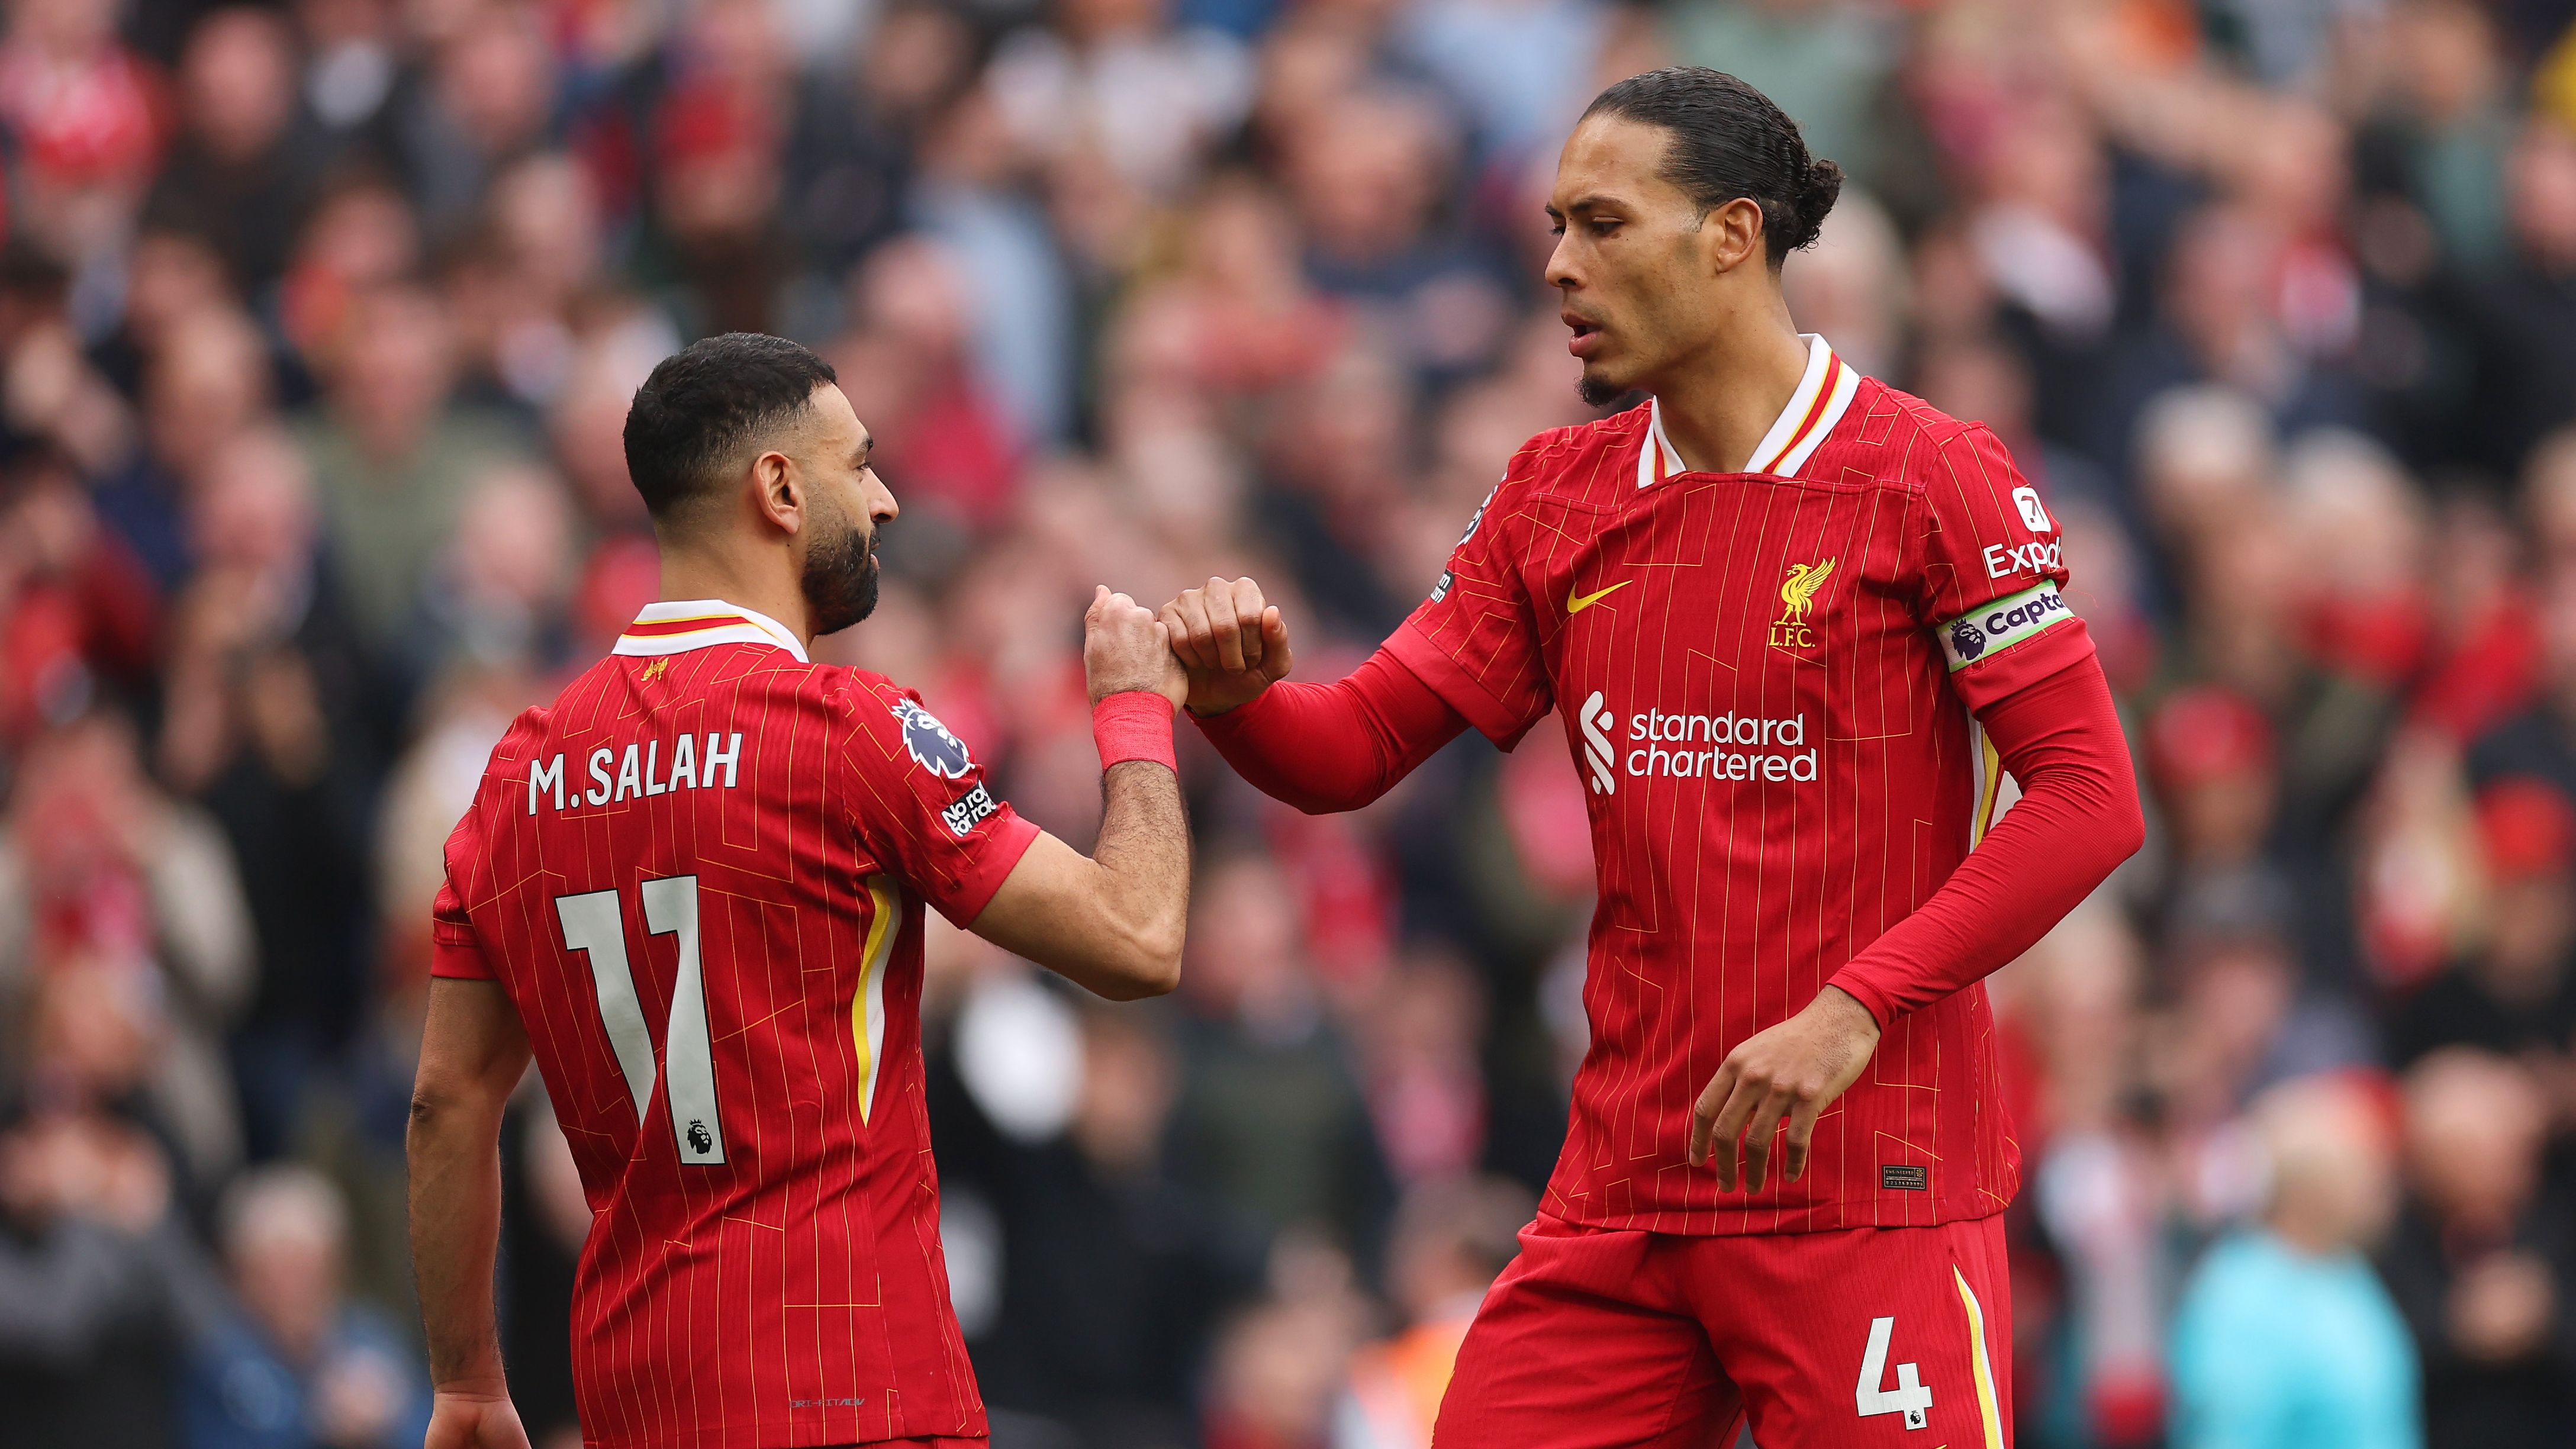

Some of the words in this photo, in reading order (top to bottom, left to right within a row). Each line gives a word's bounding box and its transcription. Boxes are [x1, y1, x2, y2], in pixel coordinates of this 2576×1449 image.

[1985, 593, 2065, 635] Capta
[1769, 627, 1815, 647] L.F.C.
[1630, 707, 1804, 745] standard
[528, 732, 743, 816] M.SALAH
[1627, 743, 1817, 781] chartered
[941, 802, 967, 827] No
[965, 780, 988, 809] ro
[950, 813, 973, 837] for
[555, 874, 726, 1165] 11
[1856, 1316, 1933, 1430] 4
